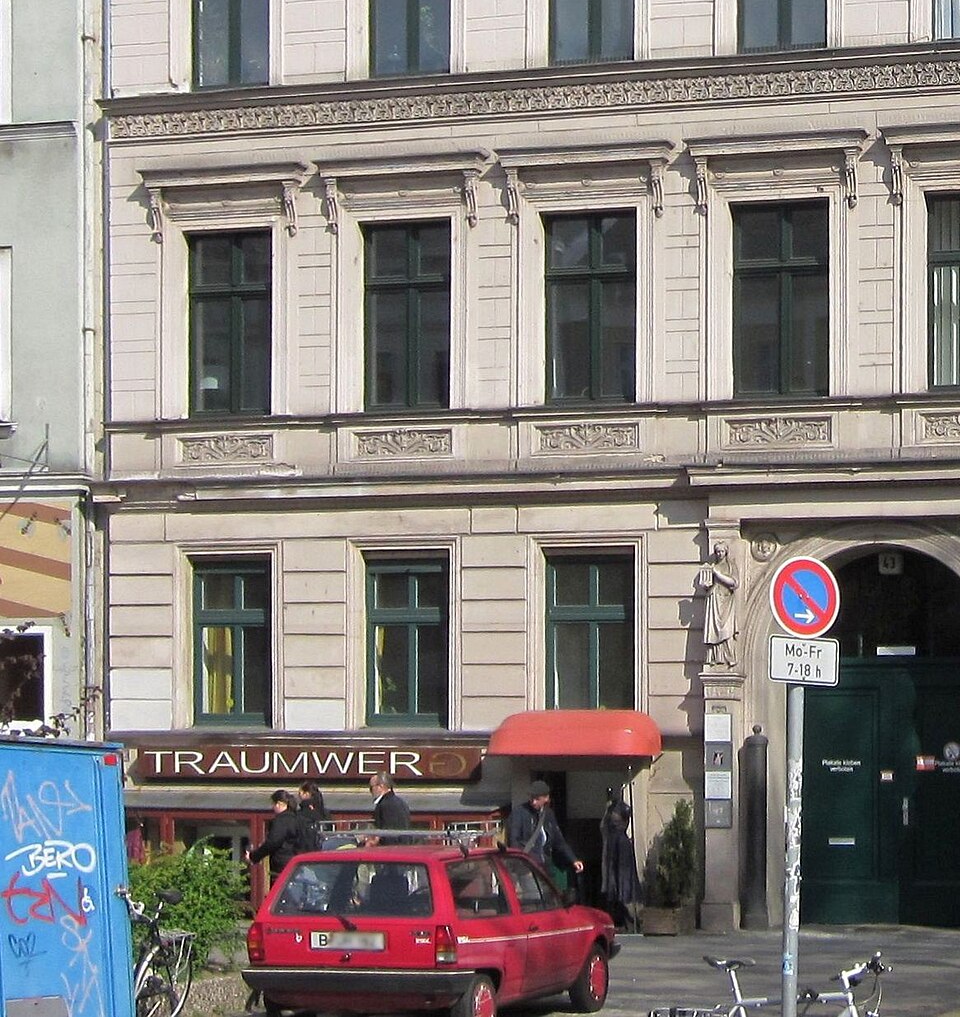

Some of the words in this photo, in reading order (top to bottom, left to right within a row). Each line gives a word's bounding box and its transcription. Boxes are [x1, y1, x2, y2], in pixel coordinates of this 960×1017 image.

[785, 643, 822, 659] Mo-Fr
[787, 662, 811, 677] 7-18
[815, 665, 821, 678] h
[319, 934, 327, 947] B
